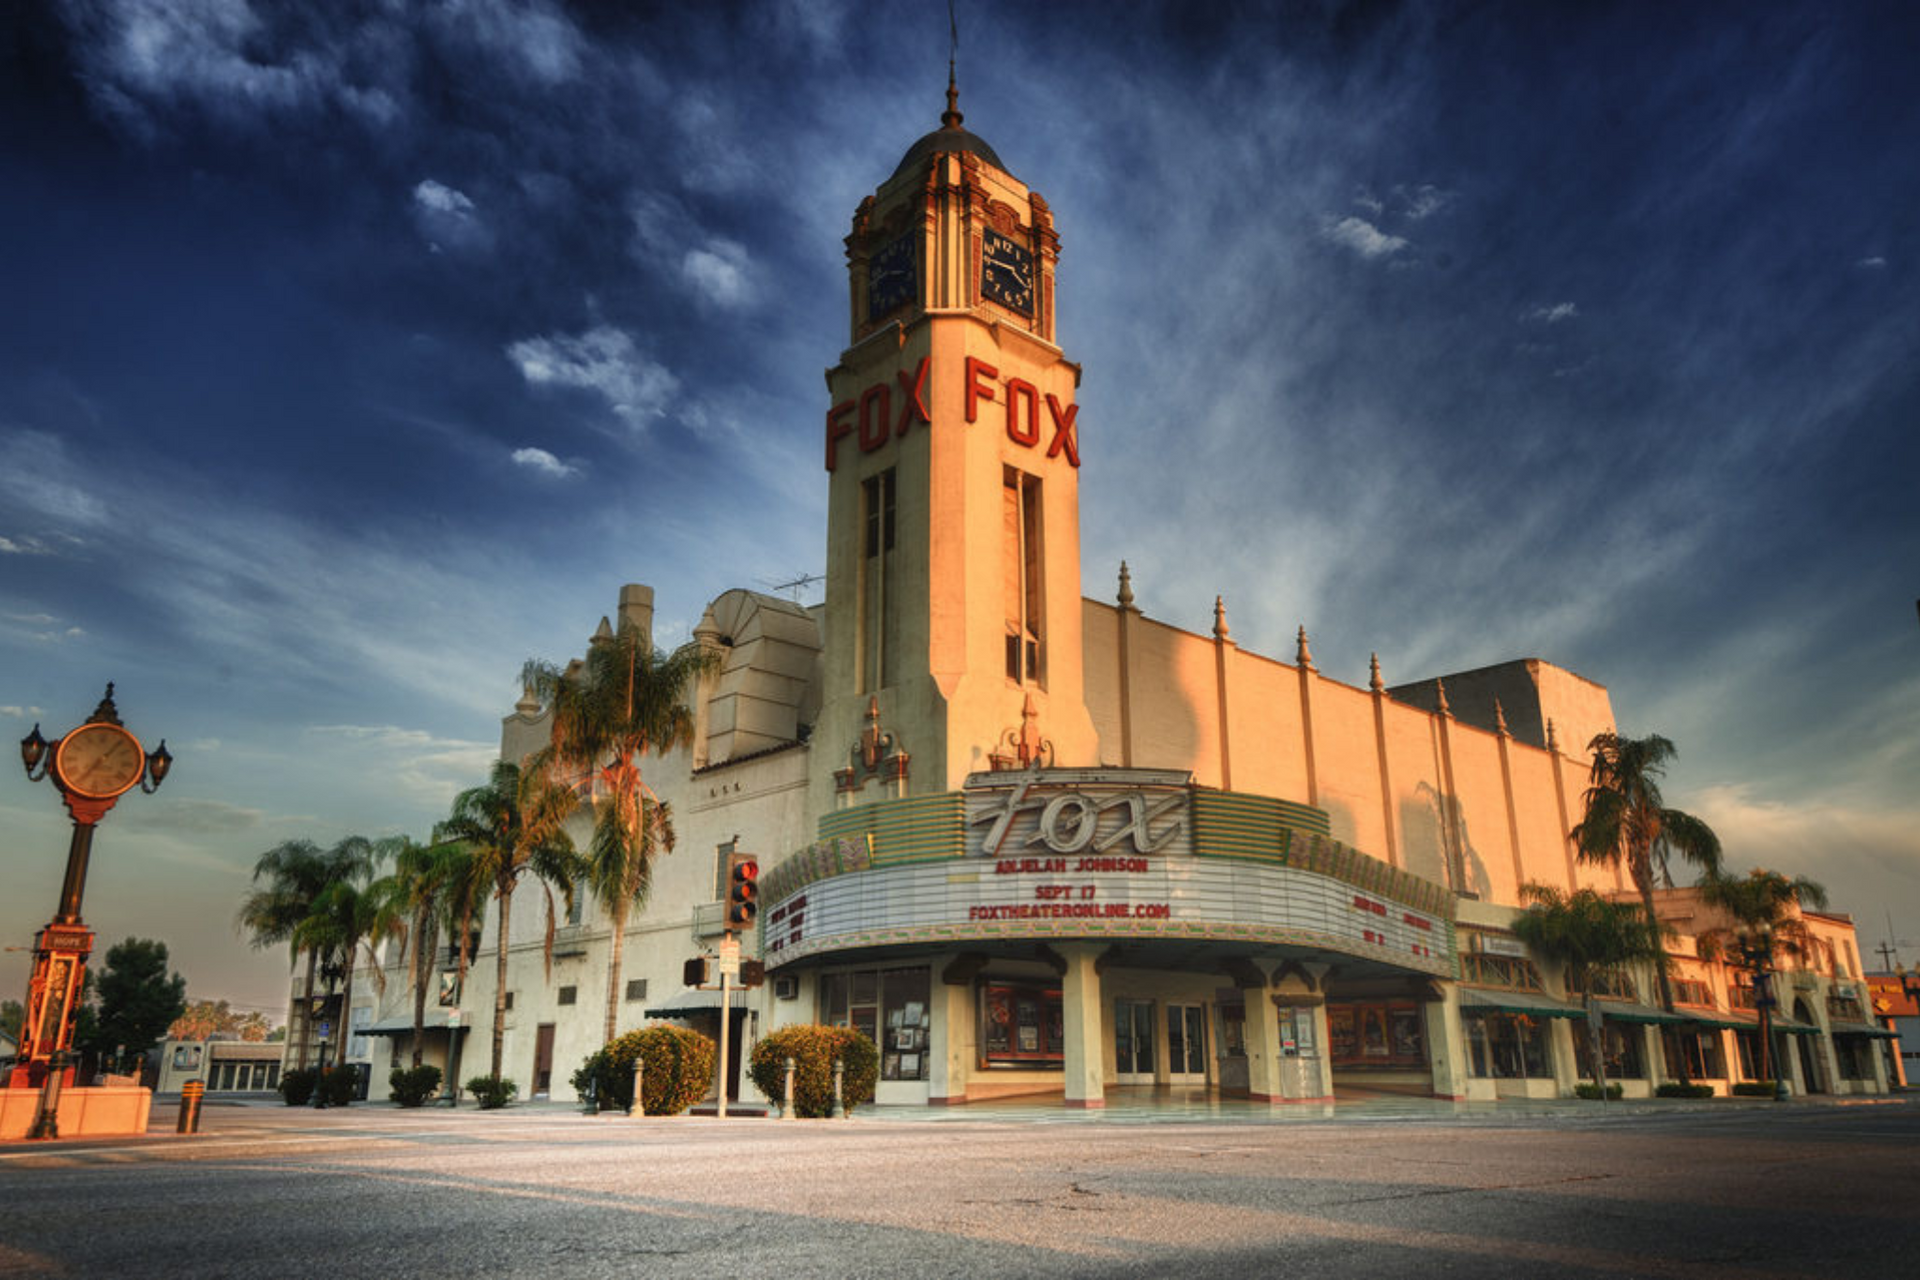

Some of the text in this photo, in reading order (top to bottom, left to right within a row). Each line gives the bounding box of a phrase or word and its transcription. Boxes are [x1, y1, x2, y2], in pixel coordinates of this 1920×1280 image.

[1003, 240, 1012, 254] 12
[826, 356, 931, 471] FOX
[965, 355, 1081, 468] FOX
[995, 857, 1149, 875] ANJELAH JOHNSON
[1035, 885, 1096, 900] SEPT 17
[968, 903, 1170, 921] FOXTHEATERONLINE.COM
